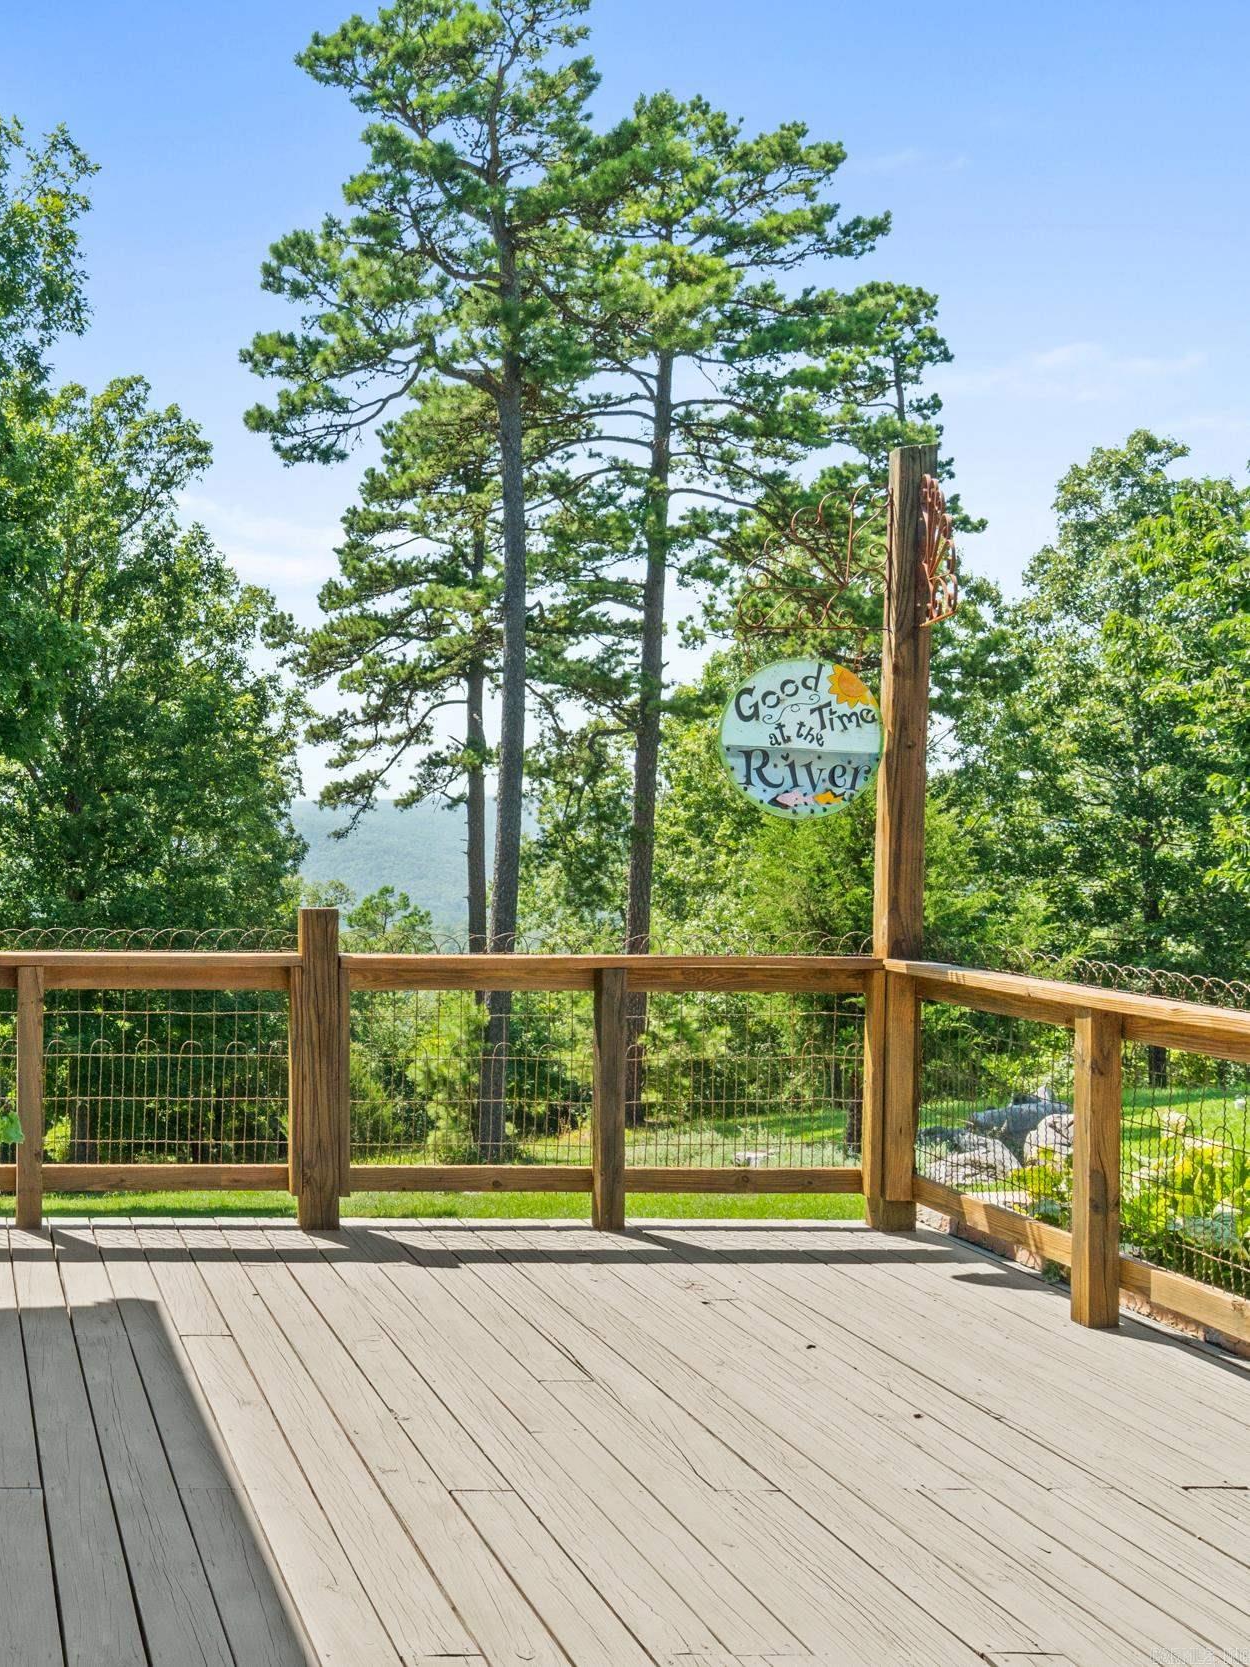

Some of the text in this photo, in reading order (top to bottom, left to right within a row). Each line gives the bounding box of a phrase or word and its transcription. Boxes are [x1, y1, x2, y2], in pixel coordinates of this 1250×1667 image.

[734, 663, 825, 722] Good
[769, 721, 825, 747] at the
[810, 701, 878, 732] Time
[738, 749, 871, 793] River
